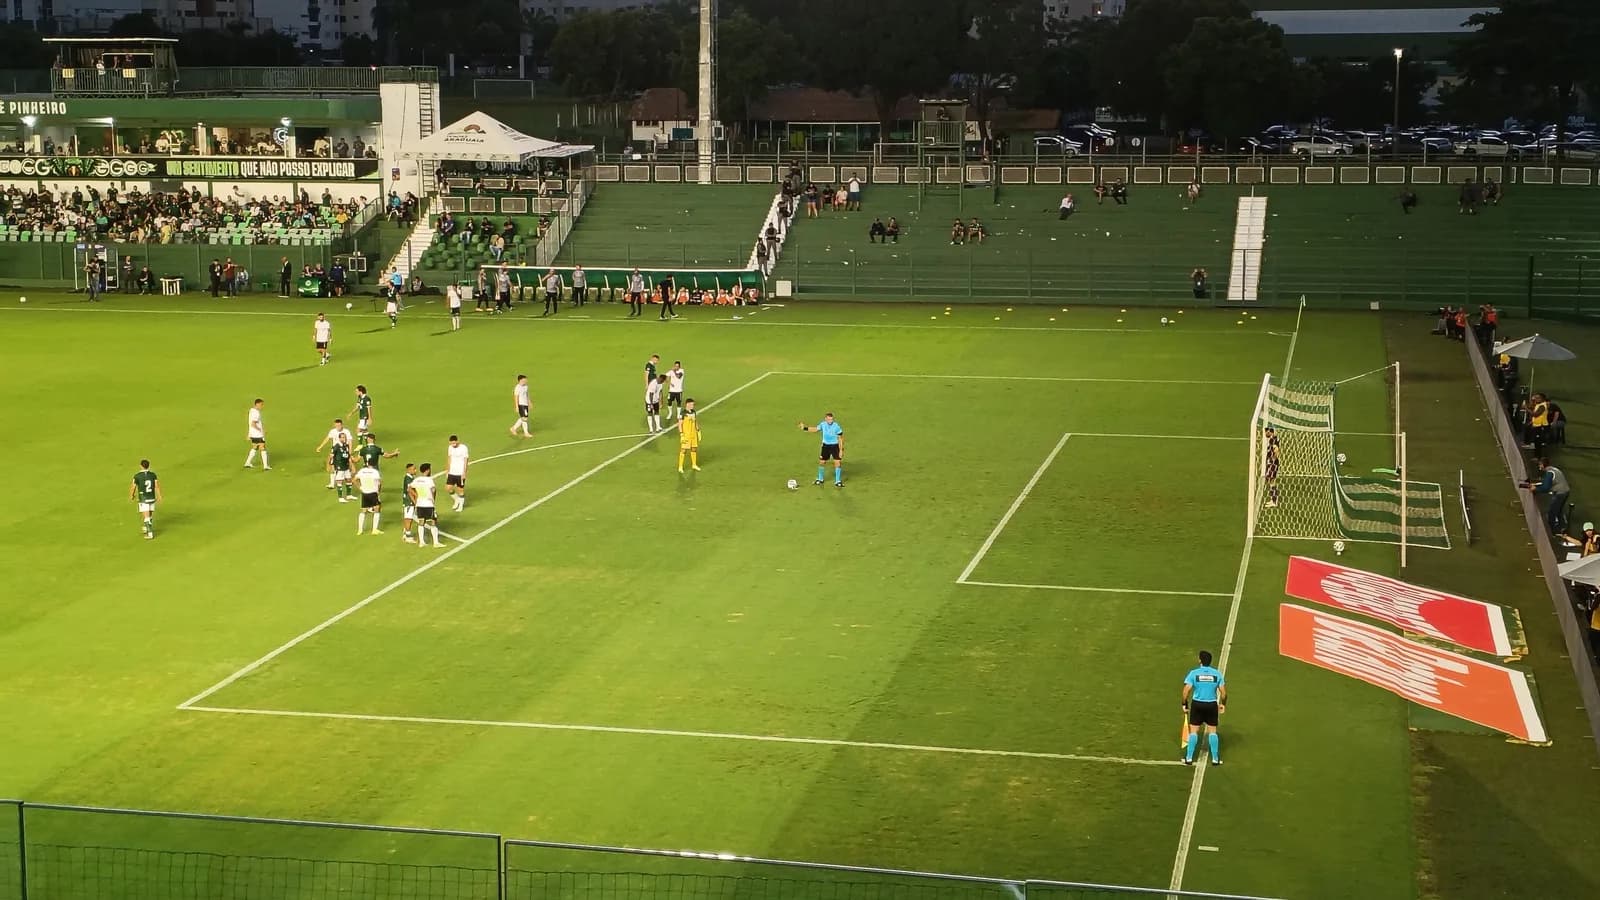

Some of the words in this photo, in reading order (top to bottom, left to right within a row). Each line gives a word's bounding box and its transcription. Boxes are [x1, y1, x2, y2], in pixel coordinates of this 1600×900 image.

[9, 101, 67, 115] PINHEIRO
[166, 161, 182, 176] UM
[183, 161, 239, 176] SENTIMENTO
[240, 161, 259, 178] QUE
[260, 160, 278, 177] NÃO
[279, 162, 310, 177] POSSO
[311, 162, 355, 177] EXPLICAR
[145, 480, 152, 493] 2
